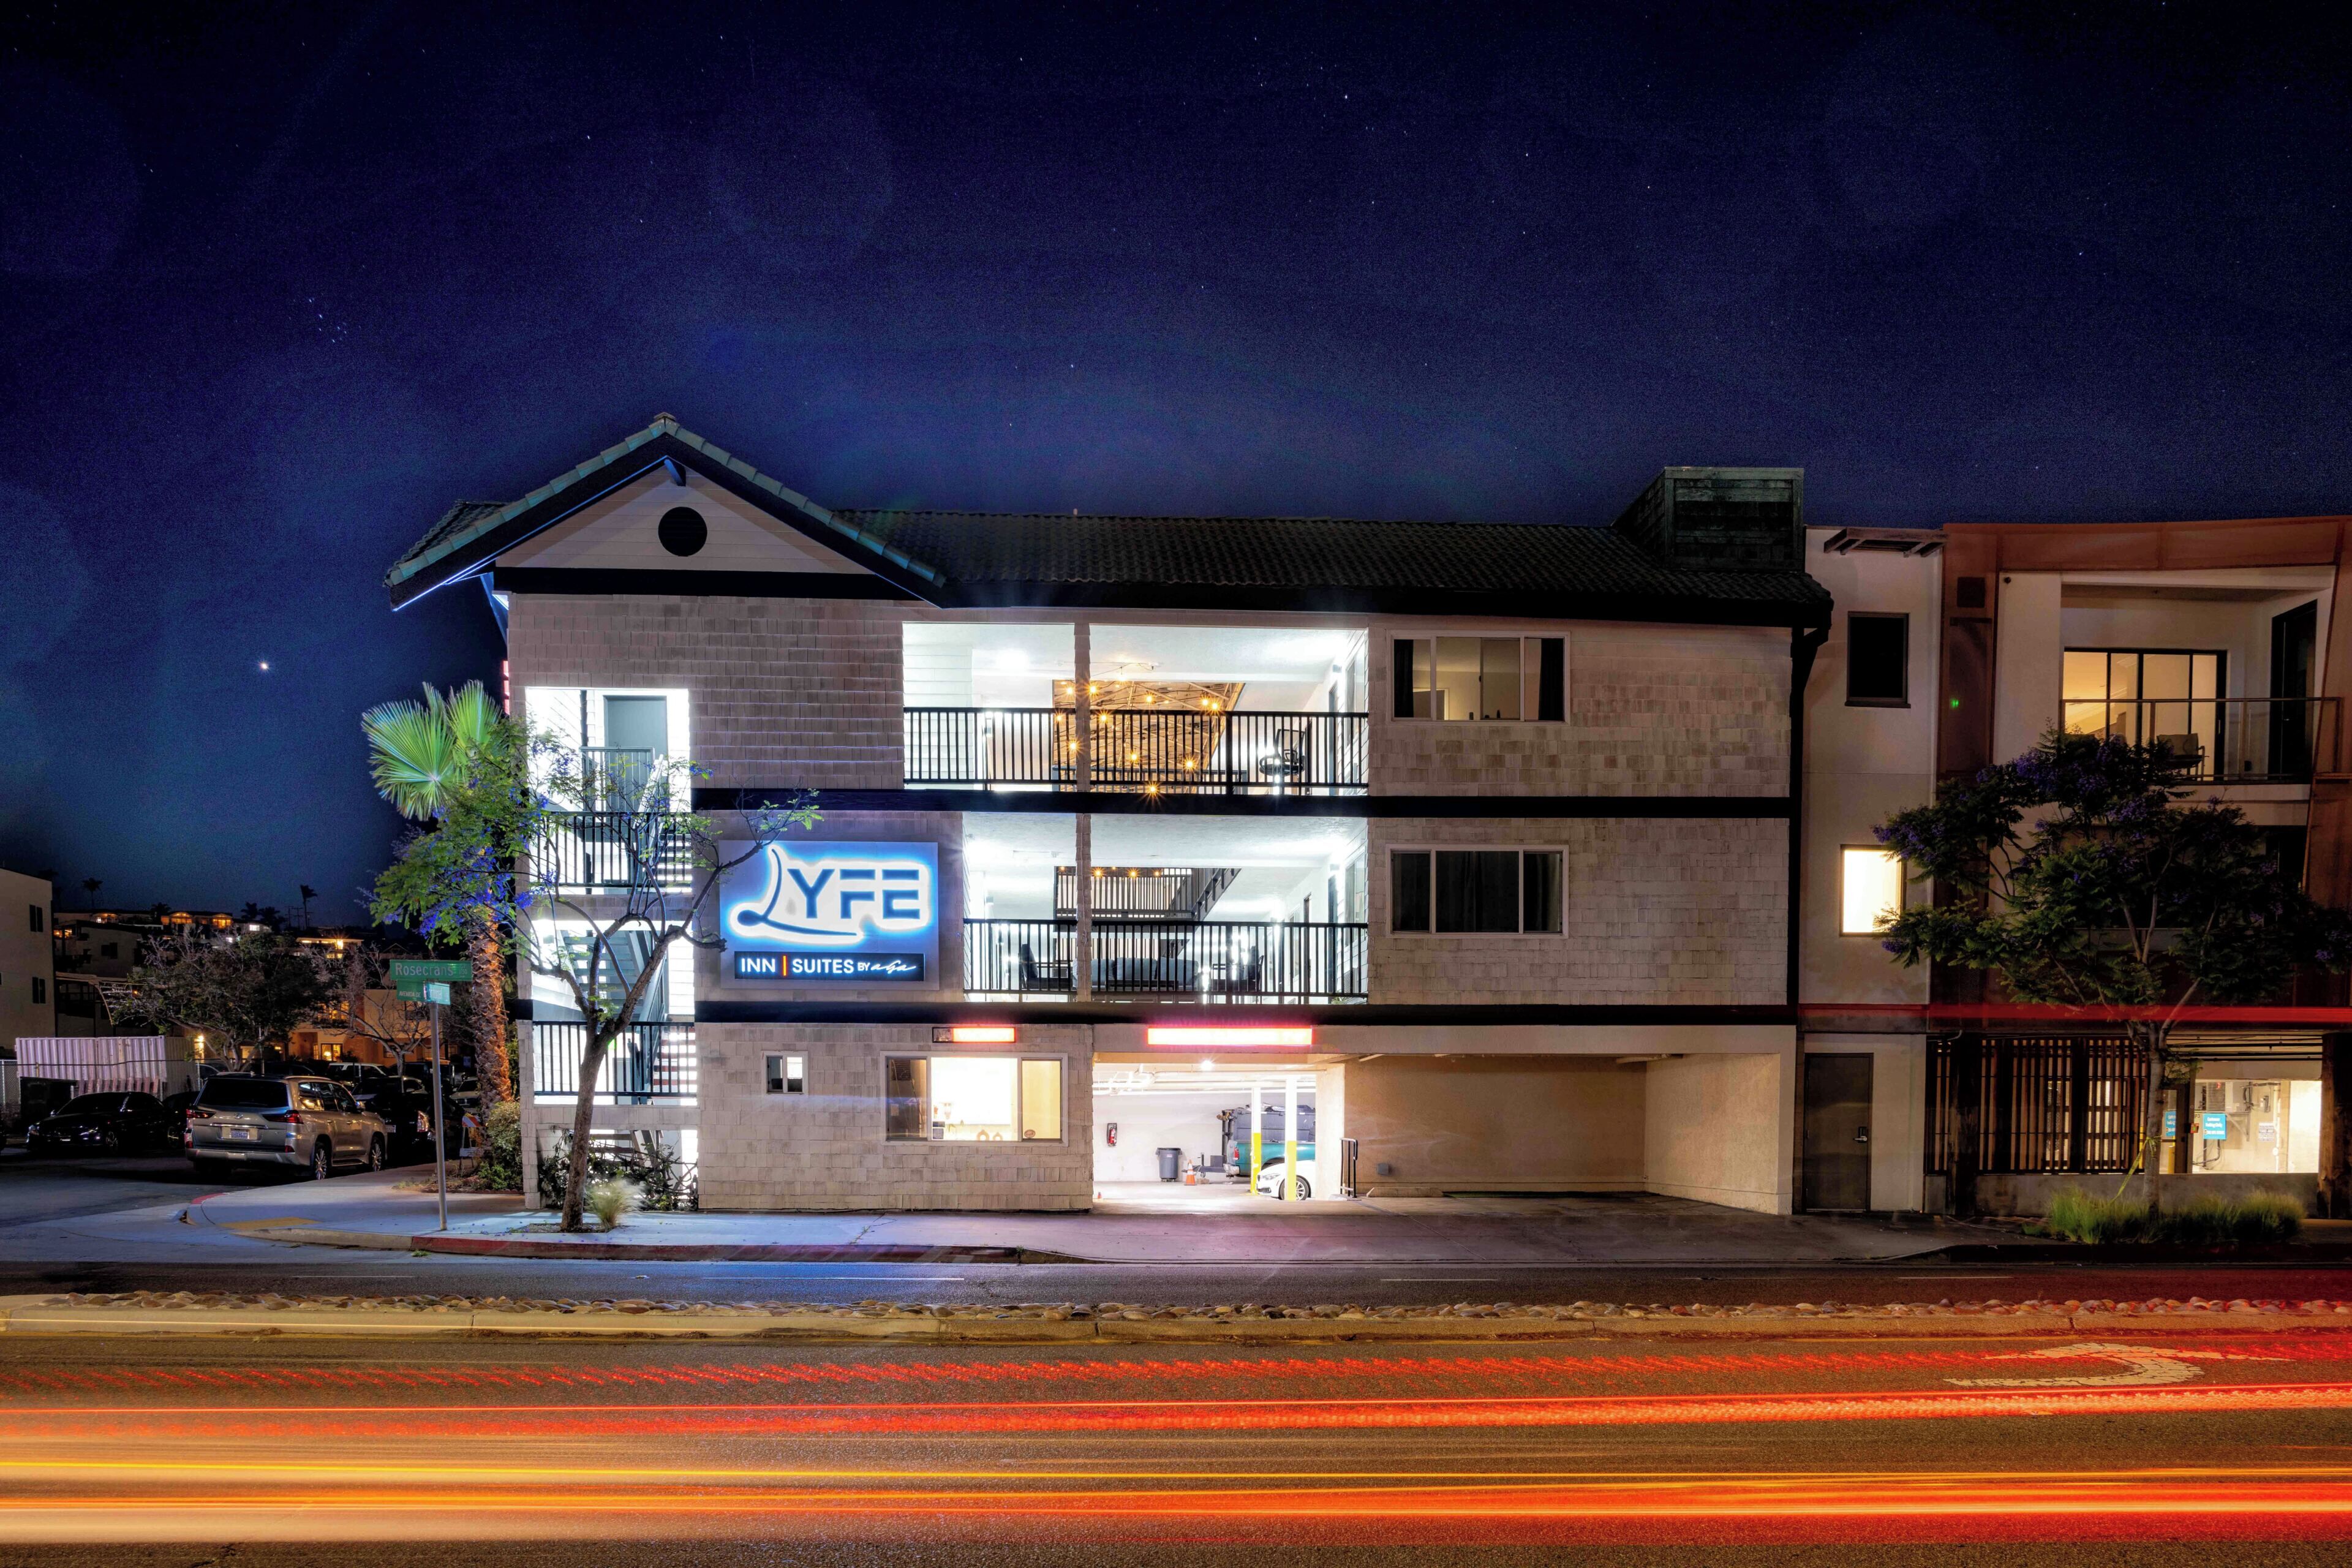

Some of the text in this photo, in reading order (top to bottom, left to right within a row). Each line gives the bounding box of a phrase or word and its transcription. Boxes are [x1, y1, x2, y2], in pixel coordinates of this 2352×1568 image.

[737, 848, 921, 936] LYFE
[395, 962, 453, 976] Rosecrans
[741, 958, 775, 973] INN
[792, 959, 854, 974] SUITES
[857, 962, 870, 971] BY
